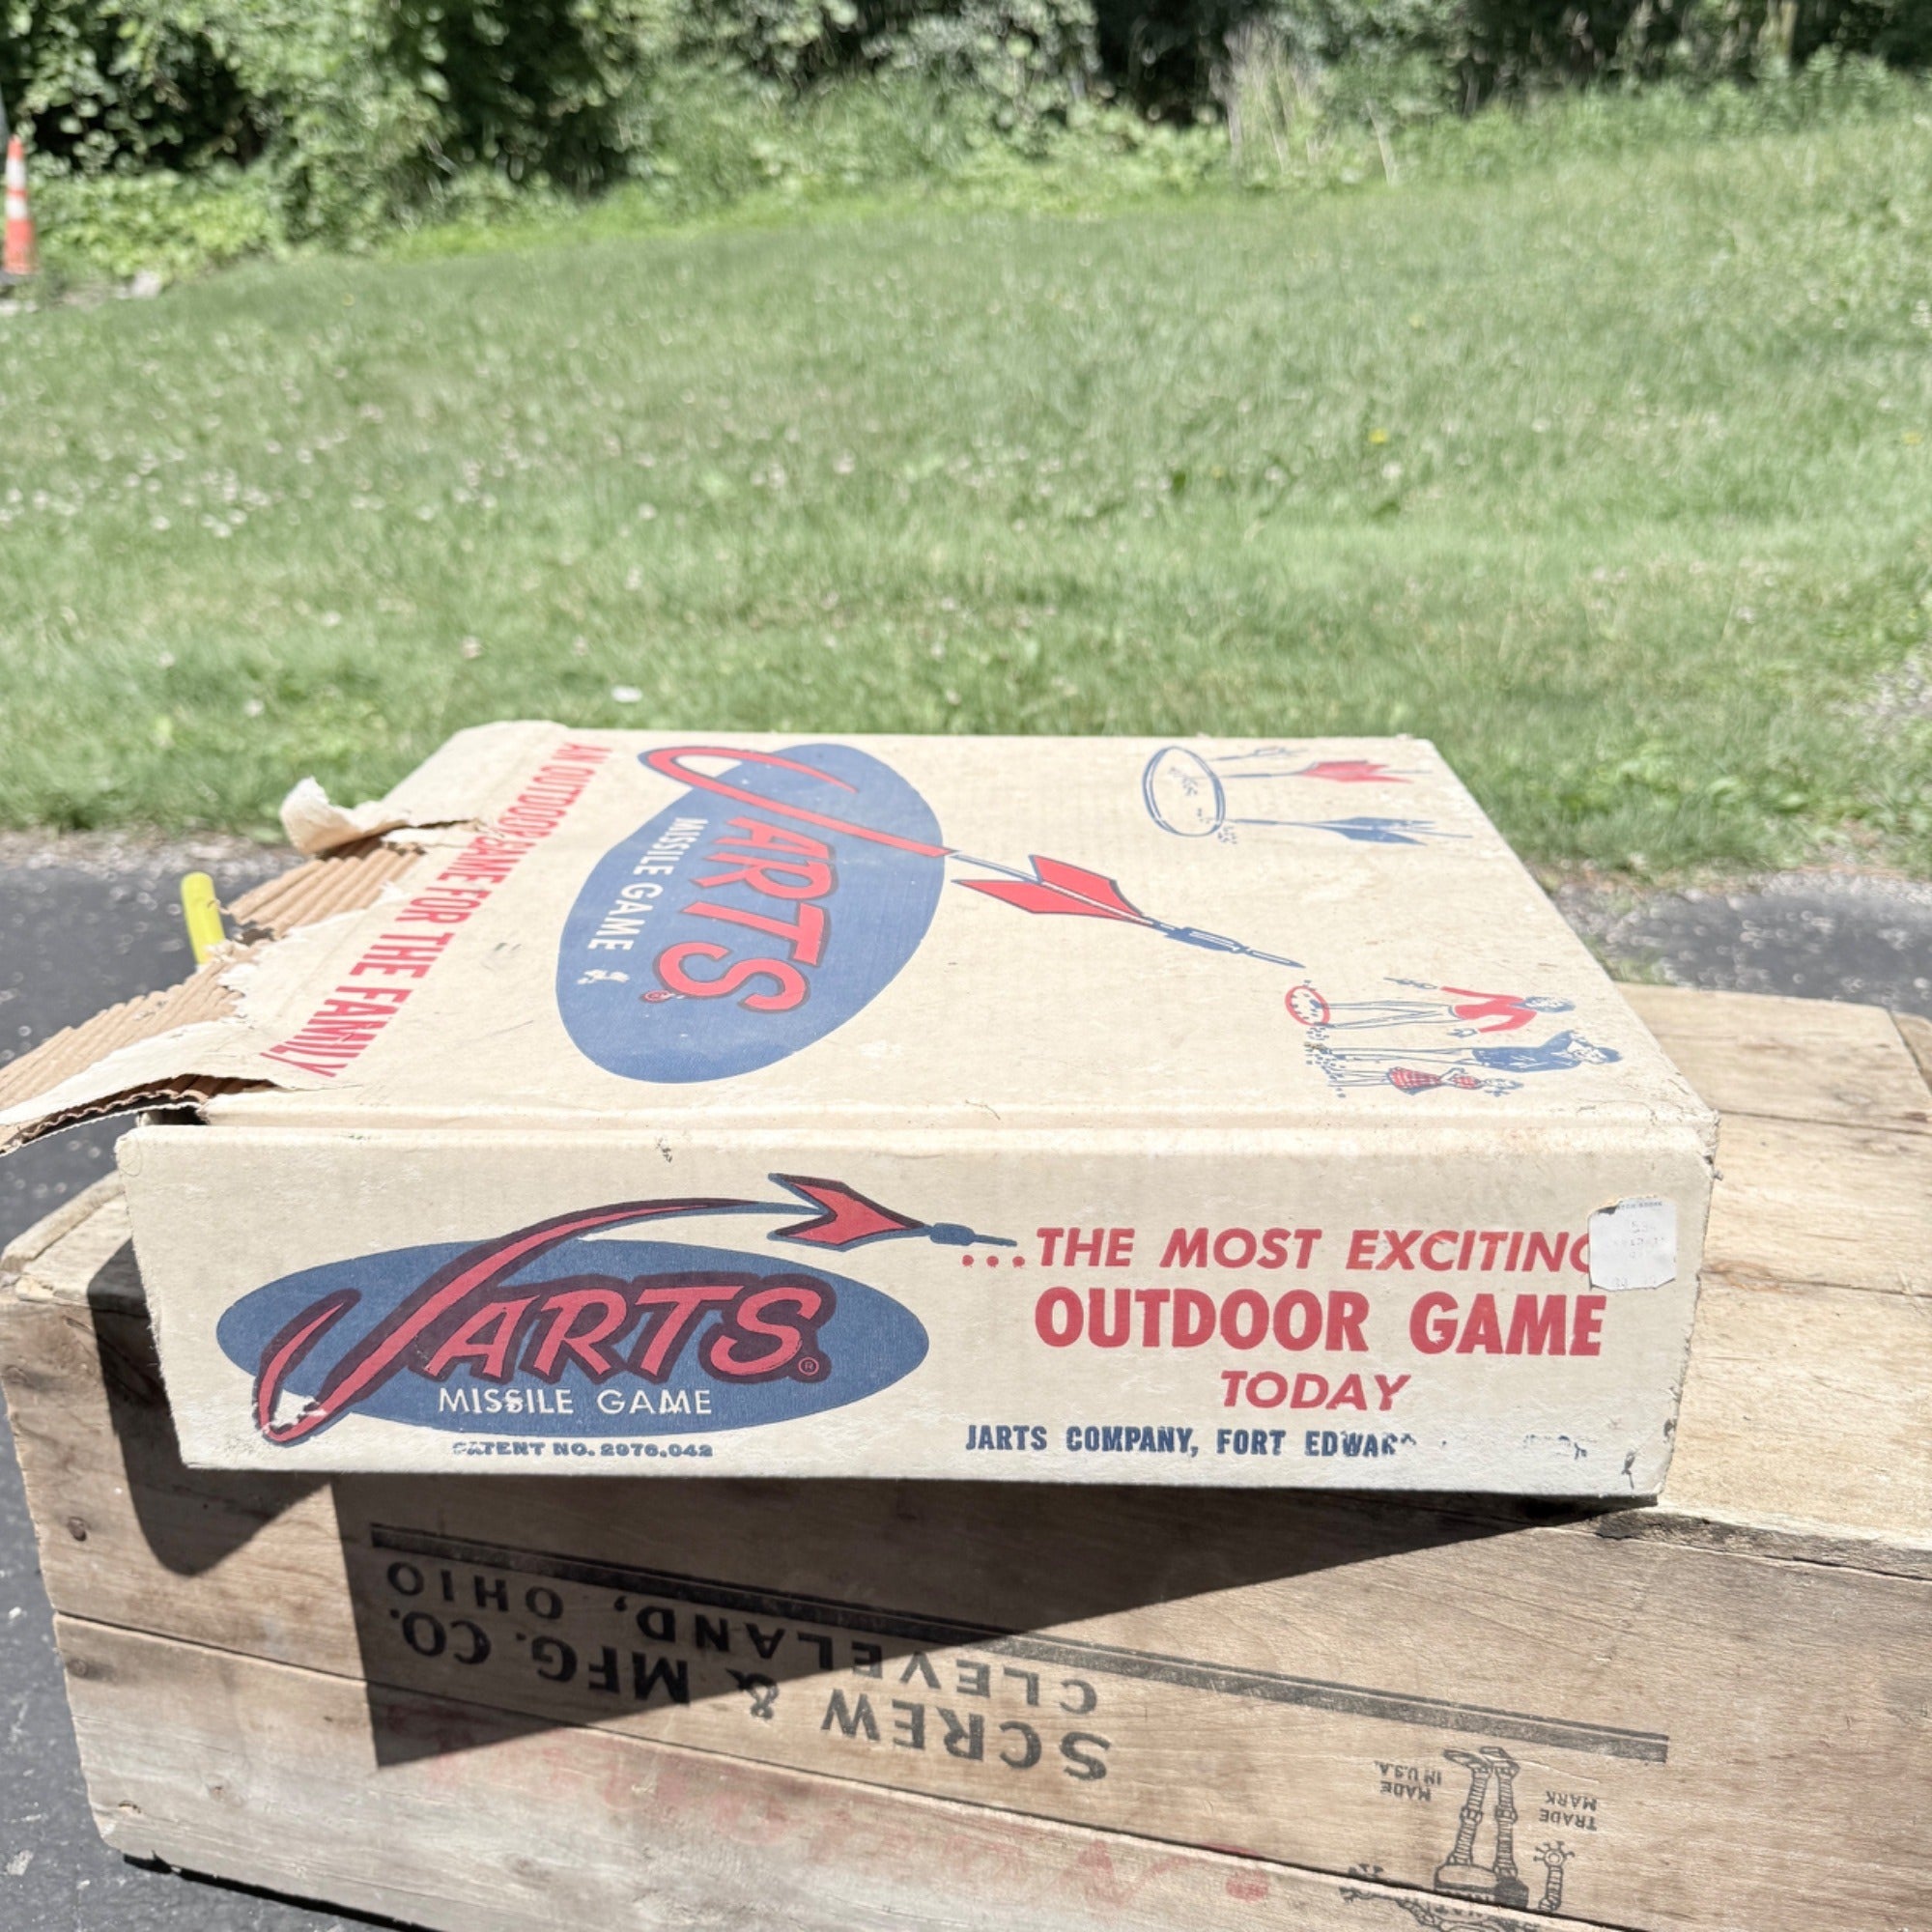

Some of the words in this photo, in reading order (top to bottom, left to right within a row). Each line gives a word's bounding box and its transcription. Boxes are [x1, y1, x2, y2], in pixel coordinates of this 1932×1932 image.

[552, 742, 612, 763] AN
[495, 765, 596, 838] OUTDOOR
[437, 836, 536, 883] GAME
[633, 816, 708, 875] MISSILE
[395, 887, 493, 924] FOR
[586, 882, 665, 951] GAME
[349, 932, 455, 979] THE
[259, 985, 413, 1077] FAMILY
[1160, 1229, 1321, 1271] MOST
[1035, 1287, 1370, 1352] OUTDOOR
[1408, 1291, 1607, 1356] GAME
[438, 1387, 574, 1415] MISSILE
[596, 1388, 713, 1415] GAME
[1220, 1371, 1411, 1411] TODAY
[553, 1442, 596, 1457] NO.
[965, 1424, 1048, 1451] JARTS
[1065, 1425, 1200, 1458] COMPANY,
[1216, 1429, 1287, 1456] FORT
[387, 1560, 564, 1621] OHIO
[389, 1608, 492, 1666] CO.
[613, 1597, 1099, 1716] CLEVELAND,
[517, 1632, 691, 1706] MFG.
[725, 1667, 781, 1720] &
[821, 1689, 1113, 1782] SCREW
[1380, 1780, 1432, 1802] MADE
[1547, 1790, 1597, 1812] MARK
[1539, 1807, 1597, 1832] TRADE
